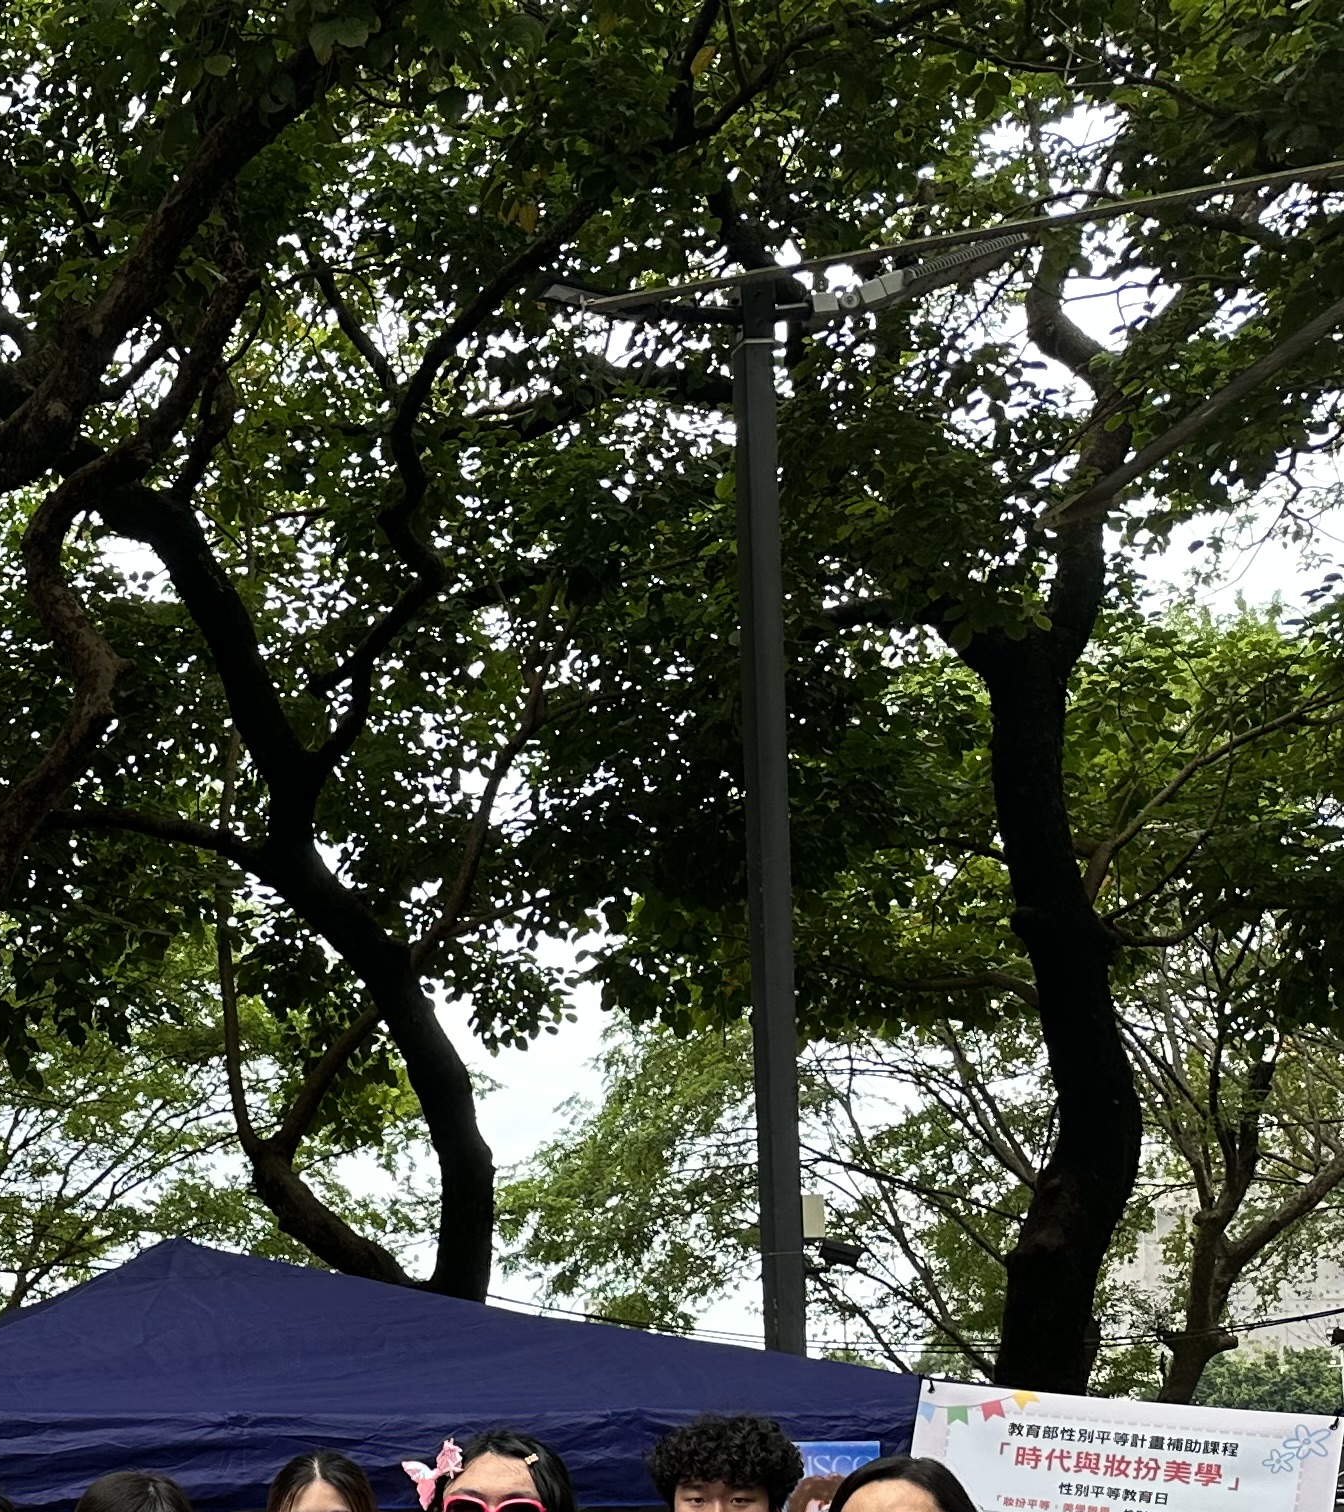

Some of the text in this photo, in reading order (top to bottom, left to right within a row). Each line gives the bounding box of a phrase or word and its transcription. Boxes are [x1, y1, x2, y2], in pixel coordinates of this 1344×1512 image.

[1008, 1422, 1239, 1457] 教育部性別平等計畫補助課程
[999, 1442, 1241, 1492] 「時代與妝扮美學」
[1058, 1481, 1169, 1506] 性別平等教育日
